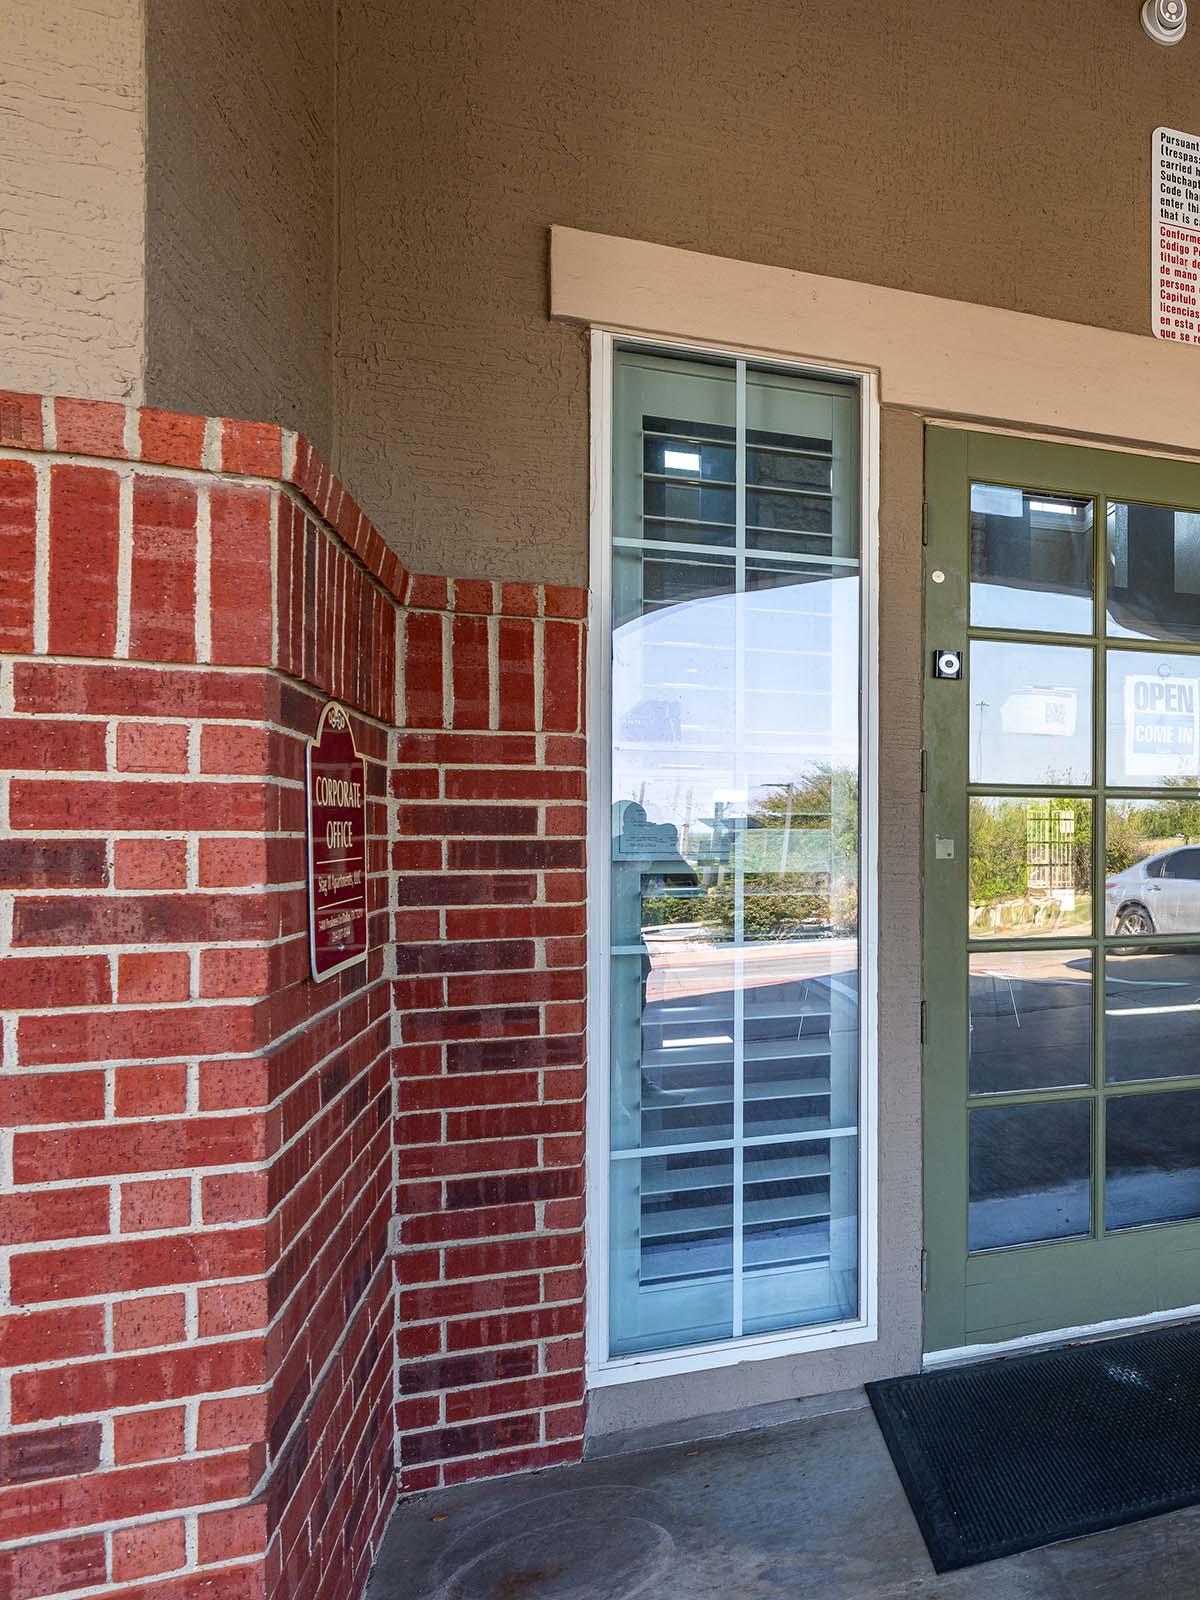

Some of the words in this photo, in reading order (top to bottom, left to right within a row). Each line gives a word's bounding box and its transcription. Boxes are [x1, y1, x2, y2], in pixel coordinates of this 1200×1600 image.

[1160, 132, 1200, 152] Pursuant
[1160, 159, 1192, 175] carried
[1160, 182, 1182, 197] Code
[1160, 196, 1184, 210] enter
[1160, 208, 1179, 222] that
[1181, 213, 1190, 225] is
[1159, 251, 1189, 267] titular
[1159, 264, 1171, 276] de
[1173, 269, 1198, 281] mano
[1159, 278, 1196, 293] persona
[1159, 302, 1200, 319] licencias
[1159, 317, 1171, 326] en
[1174, 318, 1194, 330] esta
[1159, 329, 1176, 342] que
[1179, 333, 1190, 342] se
[1134, 681, 1194, 713] OPEN
[1135, 725, 1174, 744] COME
[1178, 727, 1194, 744] IN
[316, 776, 361, 808] CORPORATE
[326, 820, 353, 849] OFFICE
